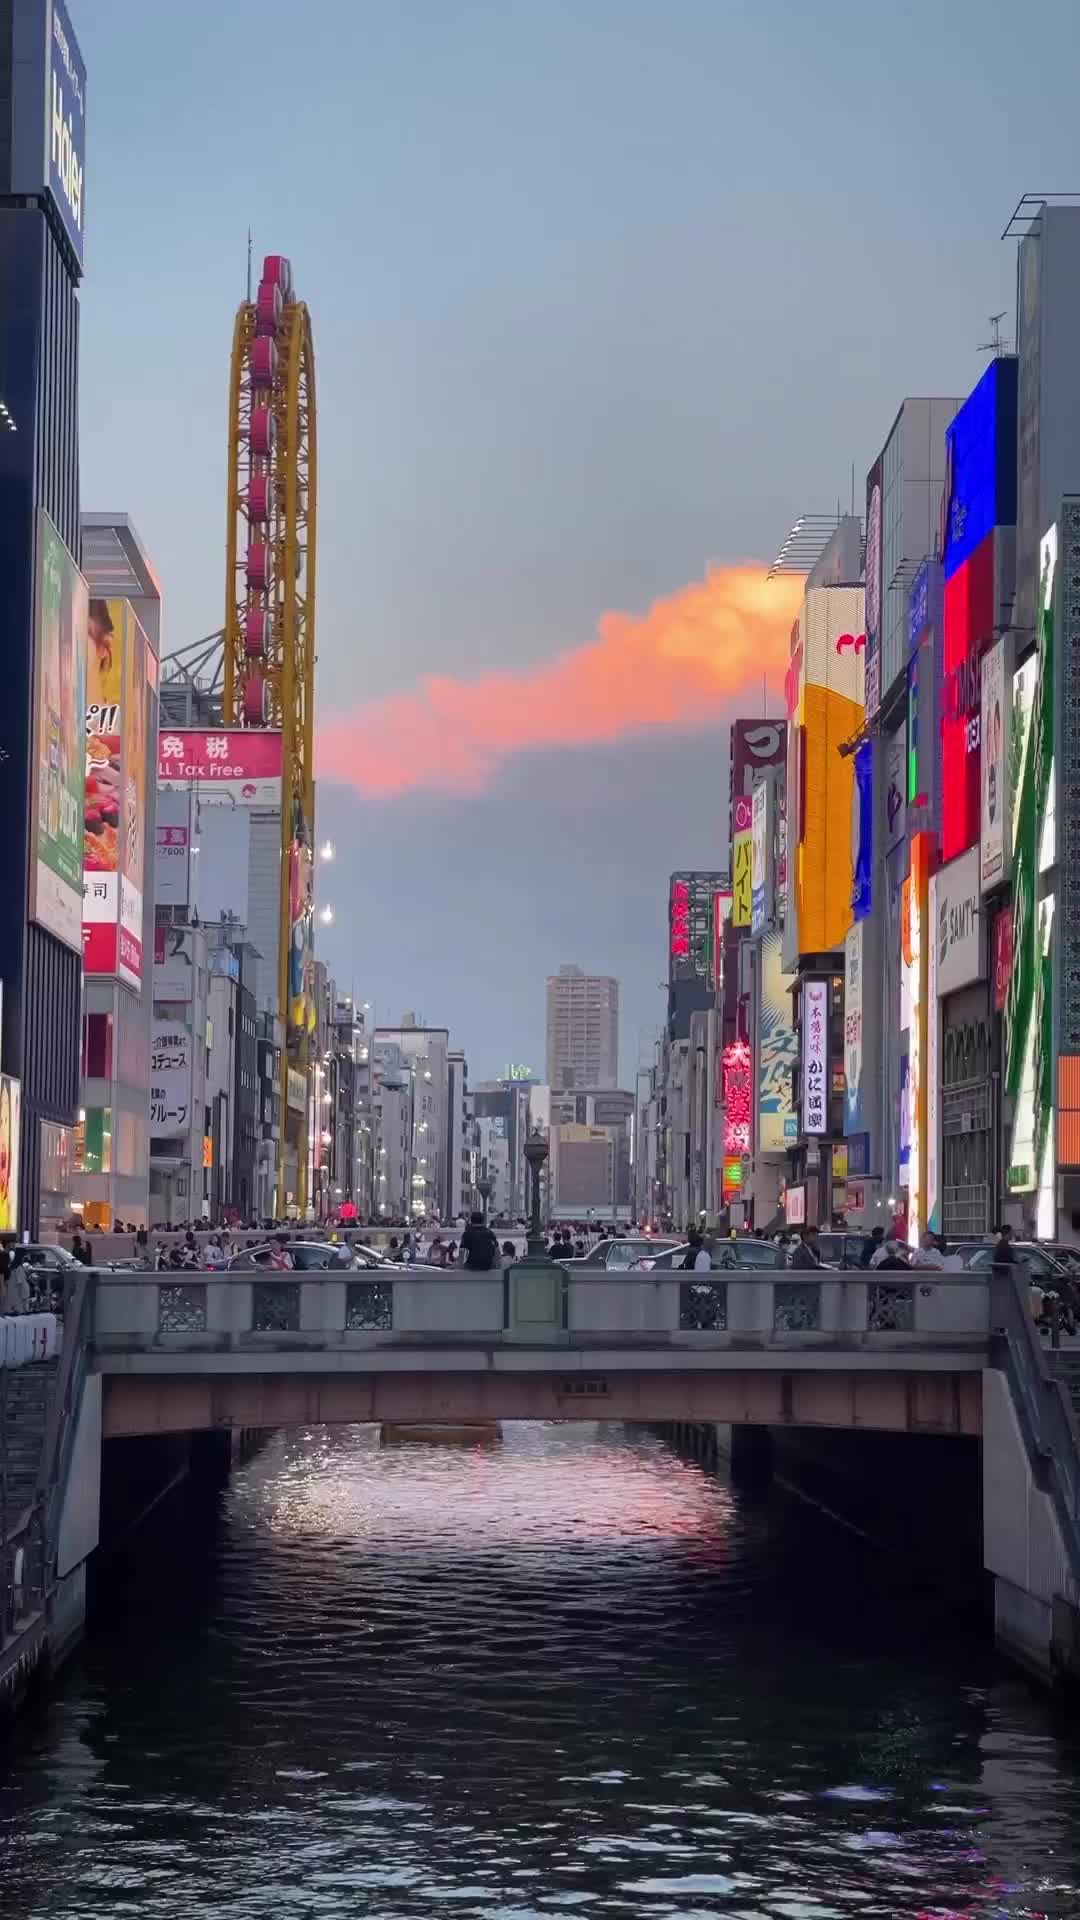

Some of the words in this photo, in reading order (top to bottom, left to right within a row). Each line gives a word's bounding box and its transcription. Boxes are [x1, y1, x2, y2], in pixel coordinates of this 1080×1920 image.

[52, 69, 83, 232] Haier
[162, 736, 228, 759] 免税
[178, 762, 205, 776] Tax
[210, 763, 244, 777] Free
[736, 840, 752, 922] バイト
[949, 896, 976, 945] SAMTY
